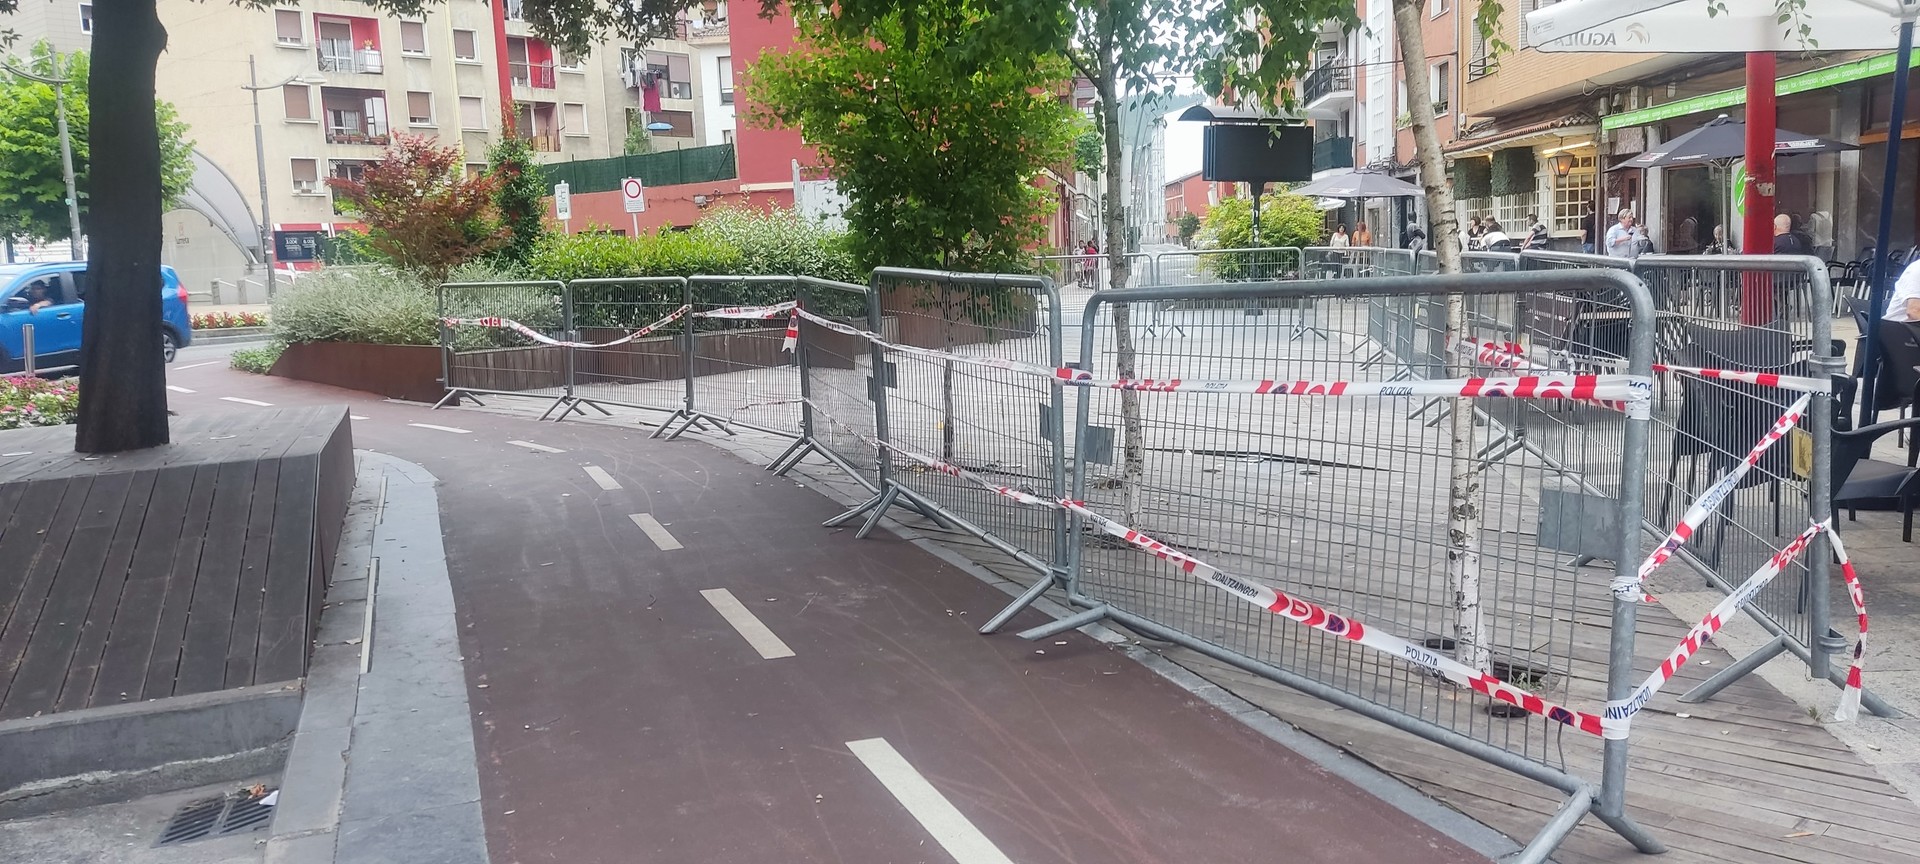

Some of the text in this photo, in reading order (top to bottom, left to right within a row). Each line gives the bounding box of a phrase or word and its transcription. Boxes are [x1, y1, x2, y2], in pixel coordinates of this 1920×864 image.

[1380, 386, 1413, 396] POLIZIA
[1211, 570, 1259, 598] UDALTZAINGOA
[1405, 645, 1438, 666] POLIZIA
